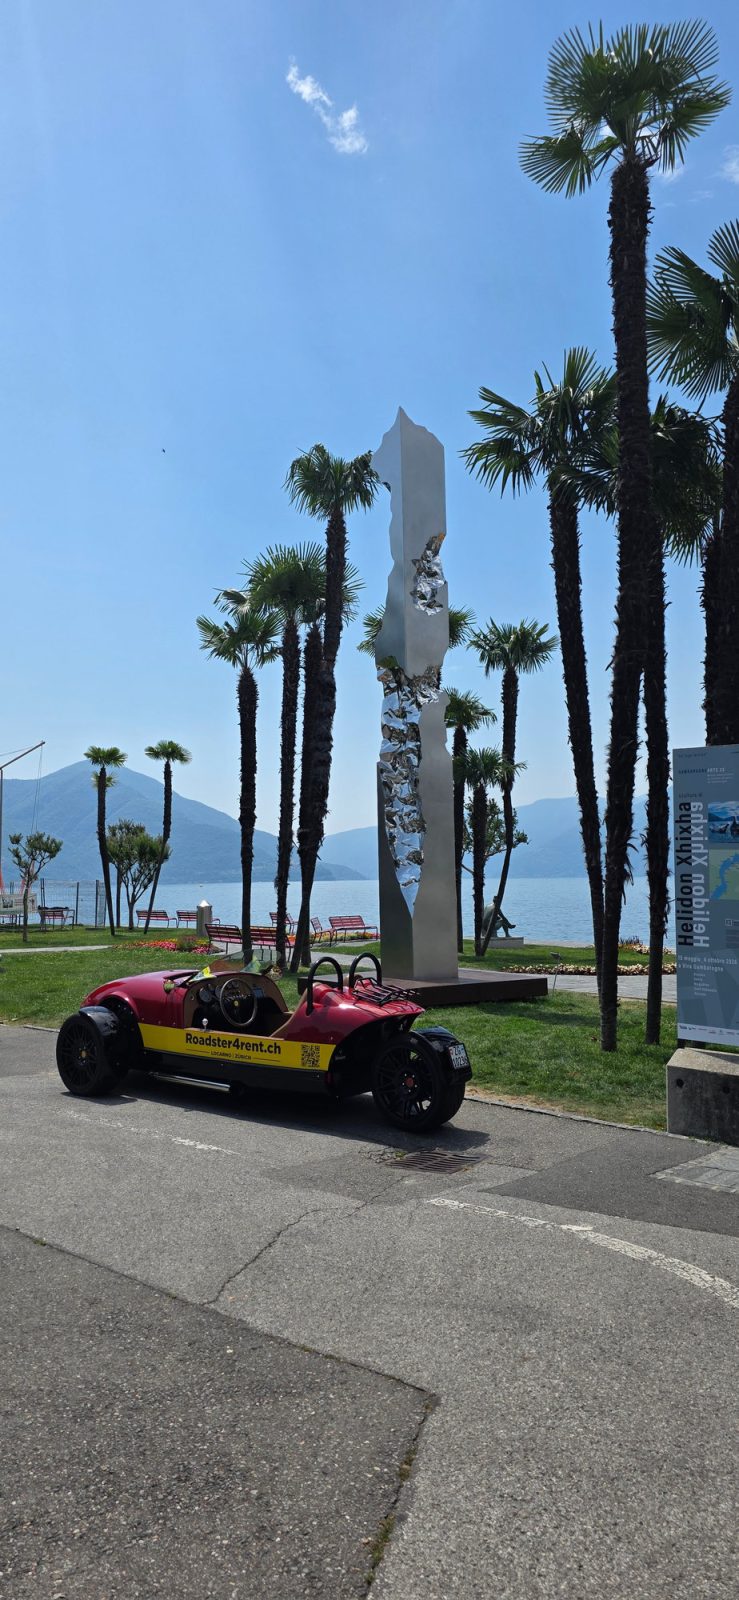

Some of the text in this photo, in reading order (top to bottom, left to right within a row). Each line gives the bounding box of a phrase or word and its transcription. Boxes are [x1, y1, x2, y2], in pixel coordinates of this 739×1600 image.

[675, 801, 692, 866] Xhixha
[677, 873, 694, 946] Helidon
[185, 1033, 281, 1054] Roadster4rent.ch
